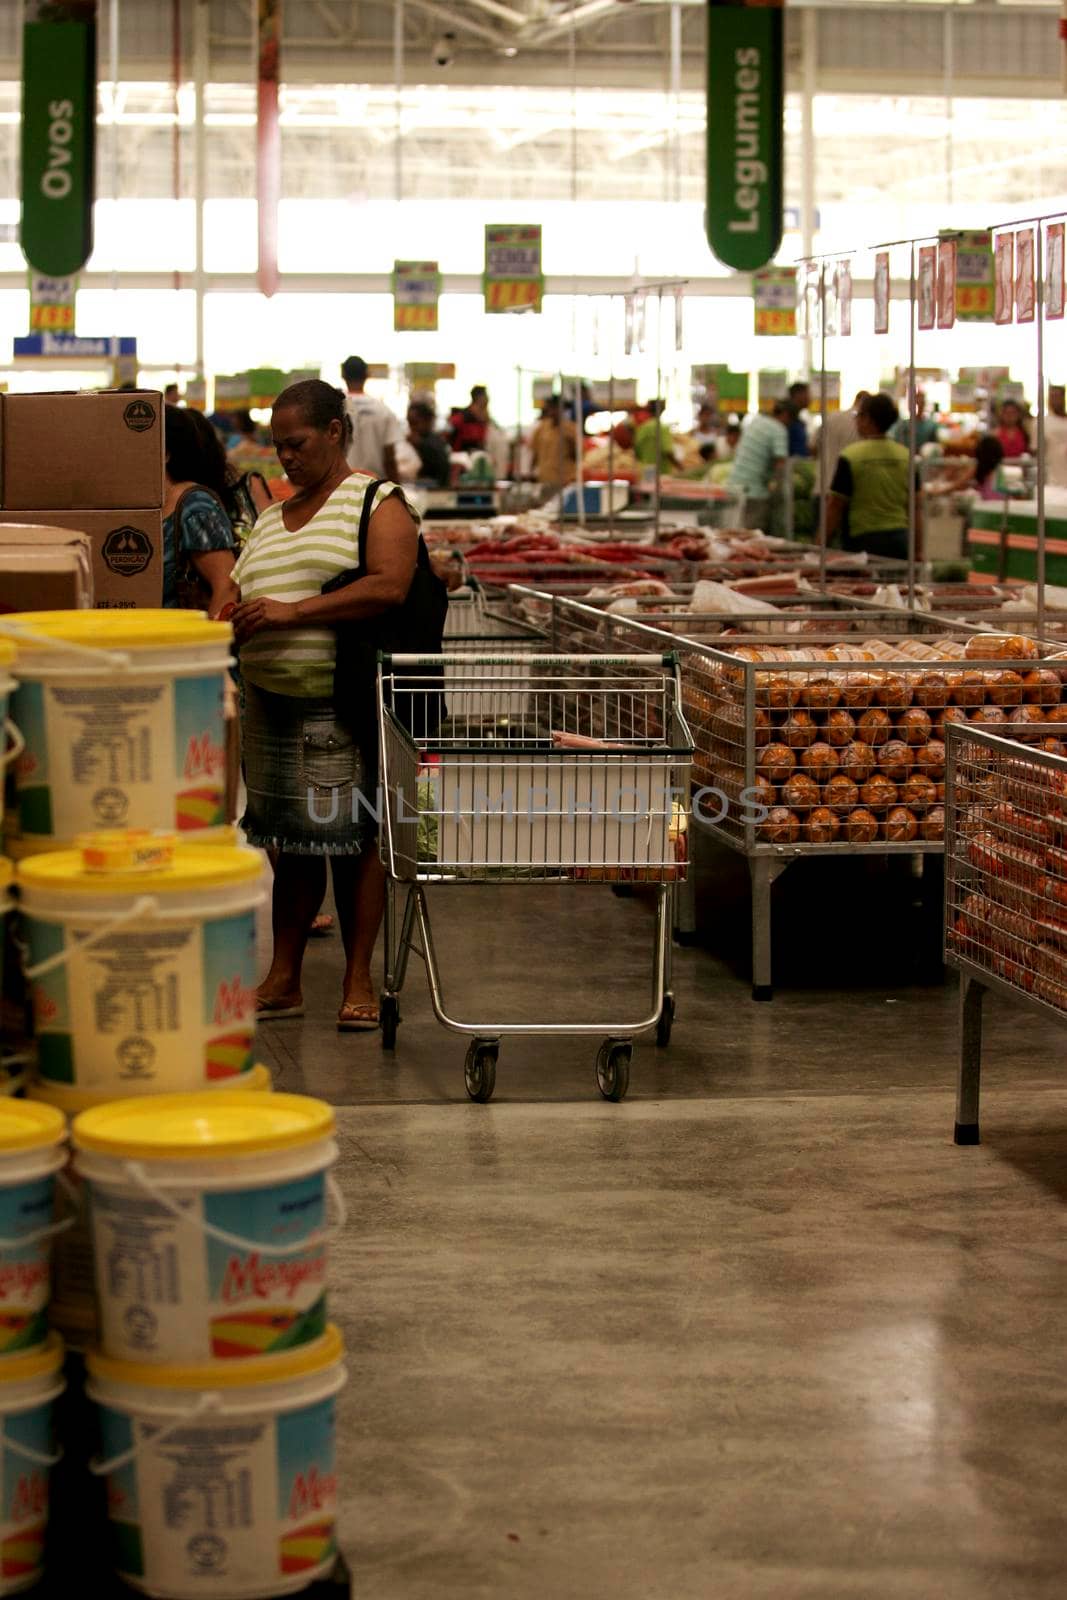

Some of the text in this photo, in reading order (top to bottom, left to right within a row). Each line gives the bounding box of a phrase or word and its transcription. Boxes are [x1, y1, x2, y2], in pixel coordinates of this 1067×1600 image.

[41, 100, 74, 198] Ovos
[729, 48, 767, 232] Legumes
[110, 553, 146, 564] PERDIGÃO
